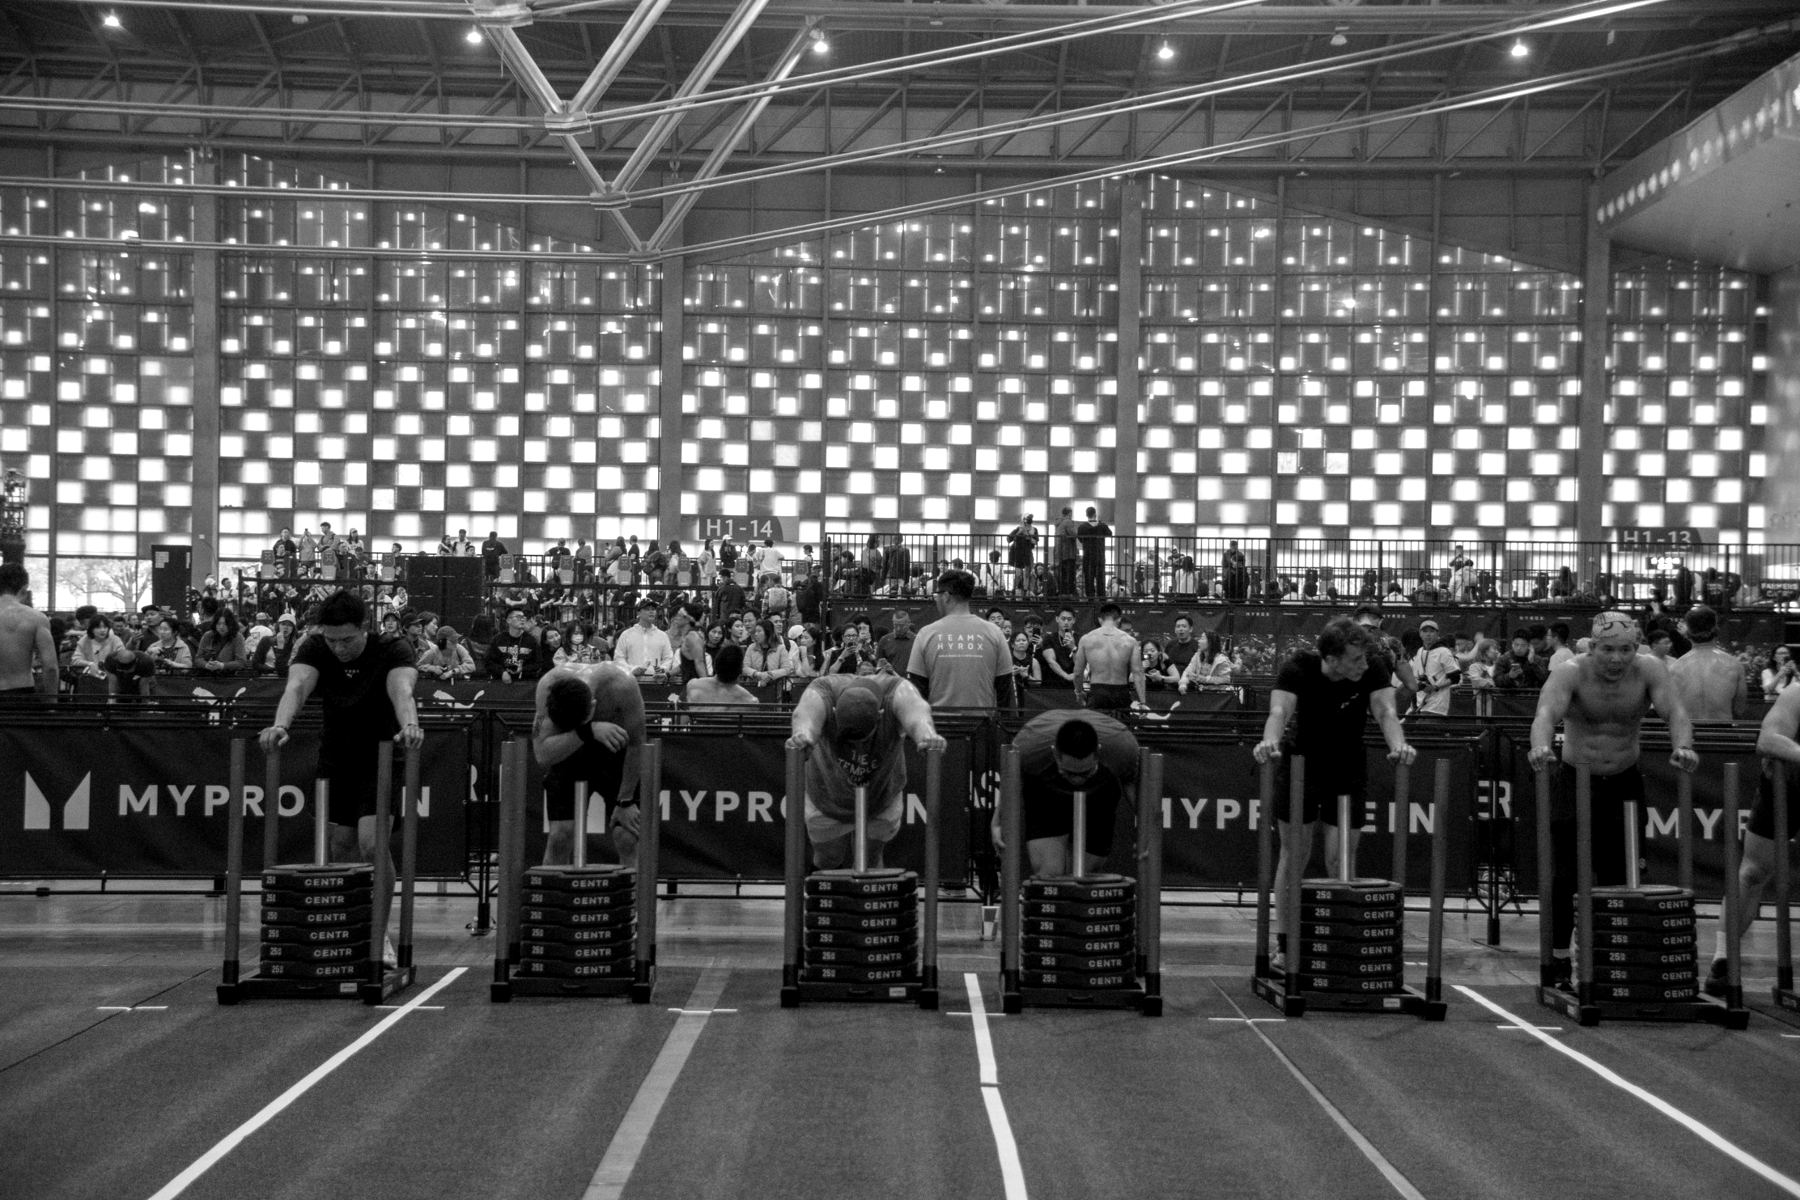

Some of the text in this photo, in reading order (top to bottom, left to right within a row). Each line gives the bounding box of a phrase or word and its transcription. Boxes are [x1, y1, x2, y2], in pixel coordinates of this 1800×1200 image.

[706, 519, 773, 538] H1-14
[1623, 530, 1692, 549] H1-13
[937, 642, 983, 650] HYROX
[304, 878, 344, 887] CENTR
[571, 880, 609, 888] CENTR
[862, 884, 898, 892] CENTR
[1090, 889, 1124, 898] CENTR
[305, 896, 345, 904] CENTR
[573, 897, 611, 905] CENTR
[1365, 894, 1395, 902] CENTR
[864, 901, 900, 909] CENTR
[1088, 907, 1122, 915] CENTR
[1363, 911, 1394, 919] CENTR
[307, 914, 346, 922] CENTR
[572, 914, 609, 922] CENTR
[861, 919, 897, 927] CENTR
[1086, 924, 1120, 933] CENTR
[1363, 928, 1394, 937] CENTR
[310, 931, 349, 939] CENTR
[574, 931, 611, 939] CENTR
[864, 936, 900, 944] CENTR
[1085, 941, 1120, 950] CENTR
[313, 948, 352, 957] CENTR
[575, 948, 612, 957] CENTR
[1360, 946, 1393, 954] CENTR
[868, 953, 902, 962] CENTR
[1088, 959, 1122, 968] CENTR
[316, 966, 354, 975] CENTR
[574, 966, 612, 974] CENTR
[1359, 964, 1392, 972] CENTR
[867, 970, 902, 979] CENTR
[1089, 976, 1123, 985] CENTR
[1361, 981, 1393, 989] CENTR
